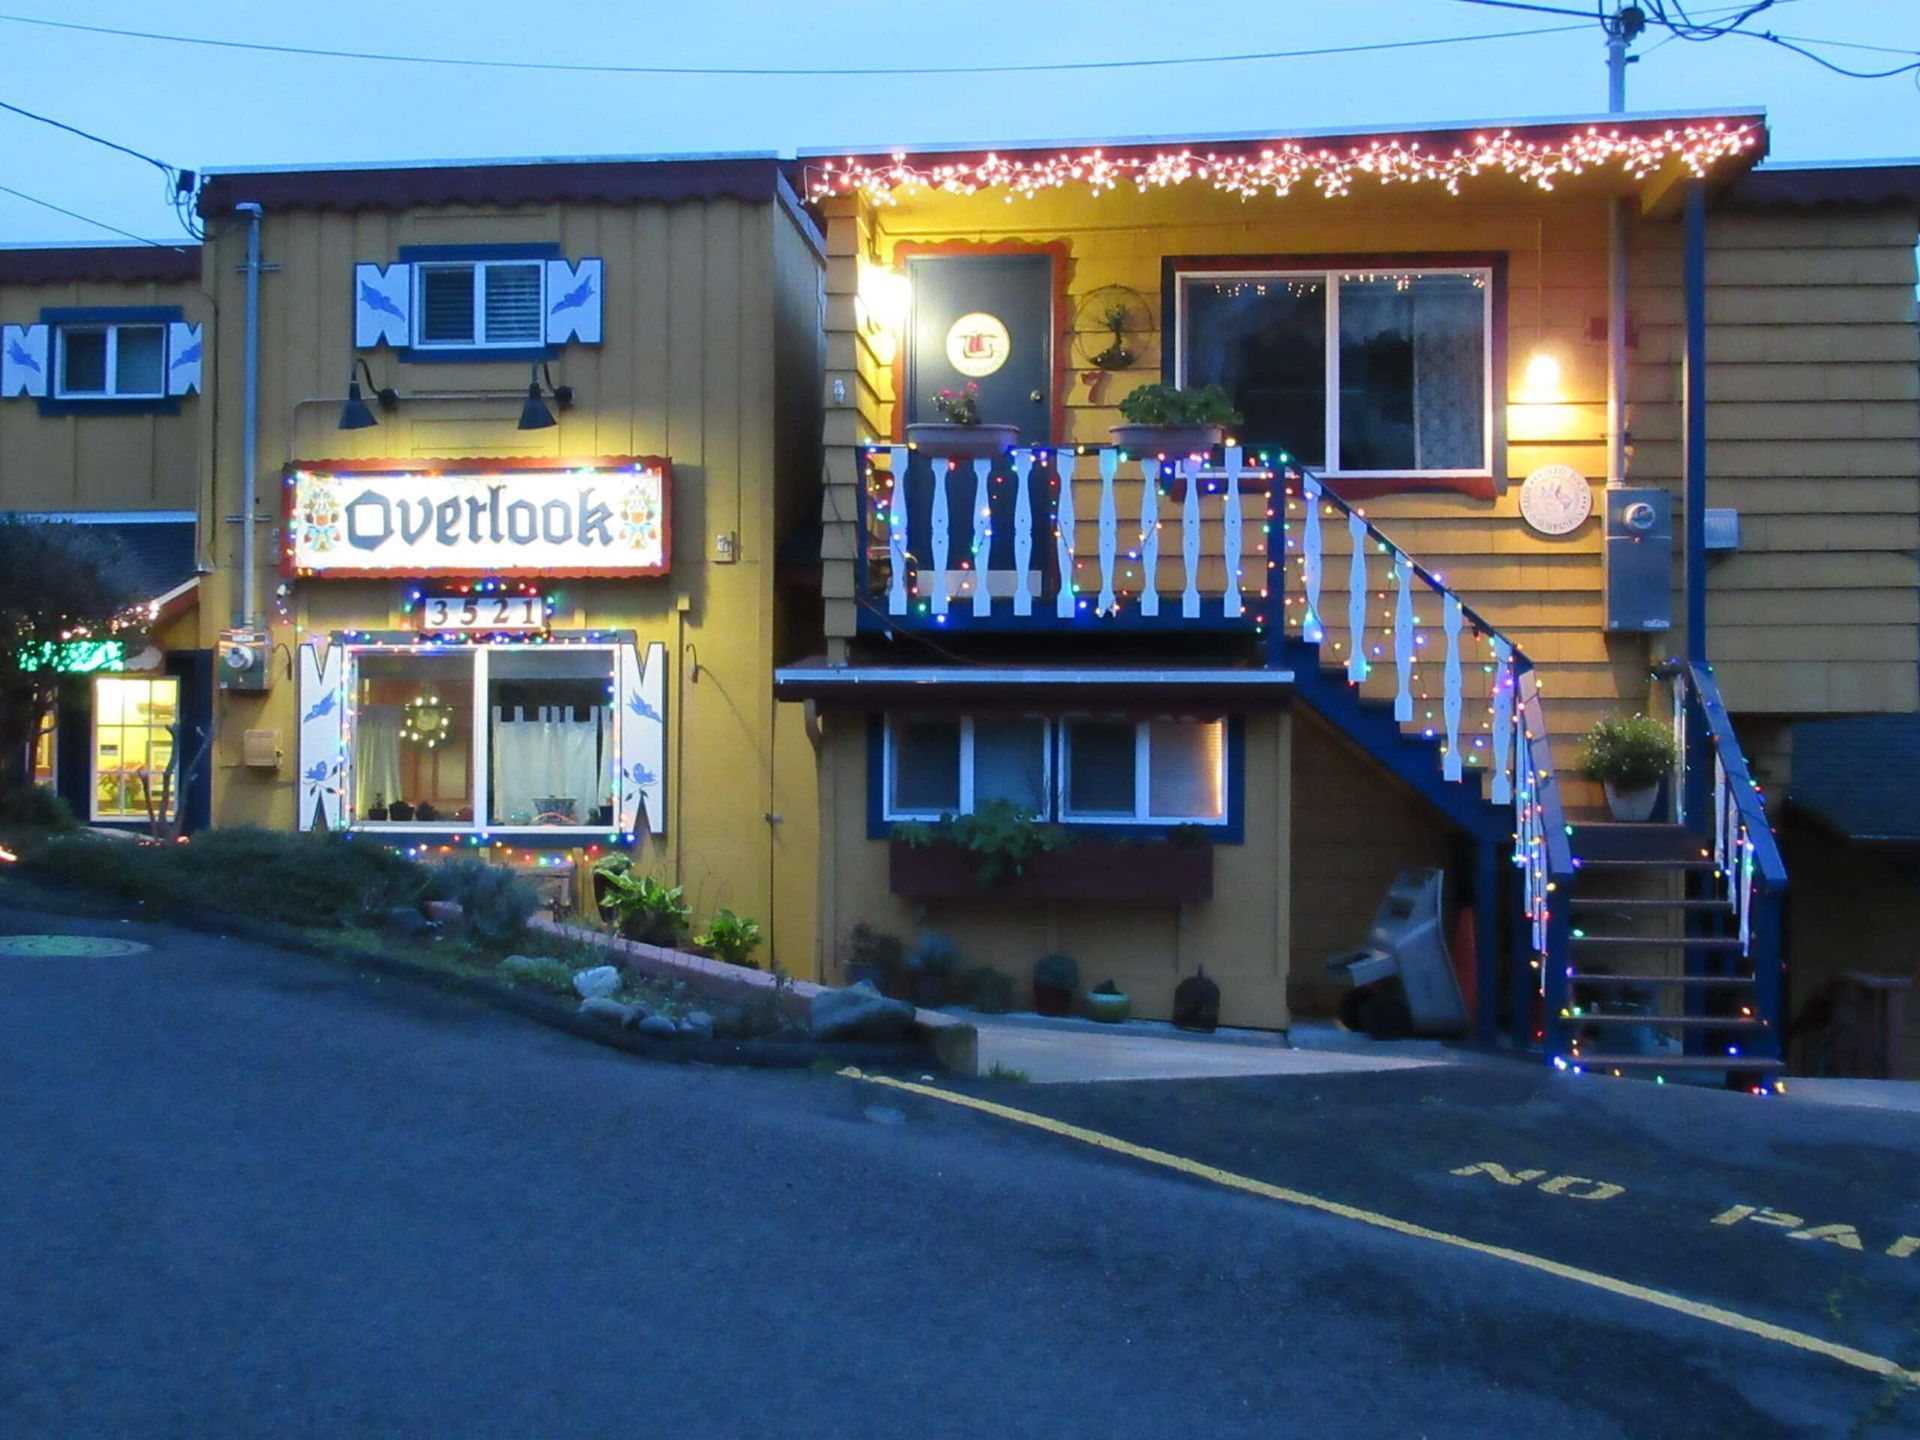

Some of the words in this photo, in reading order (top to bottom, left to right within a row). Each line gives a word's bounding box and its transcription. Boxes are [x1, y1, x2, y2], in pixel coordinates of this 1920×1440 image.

[345, 485, 614, 552] Overlook
[430, 597, 536, 626] 3521
[1450, 1161, 1626, 1201] NO
